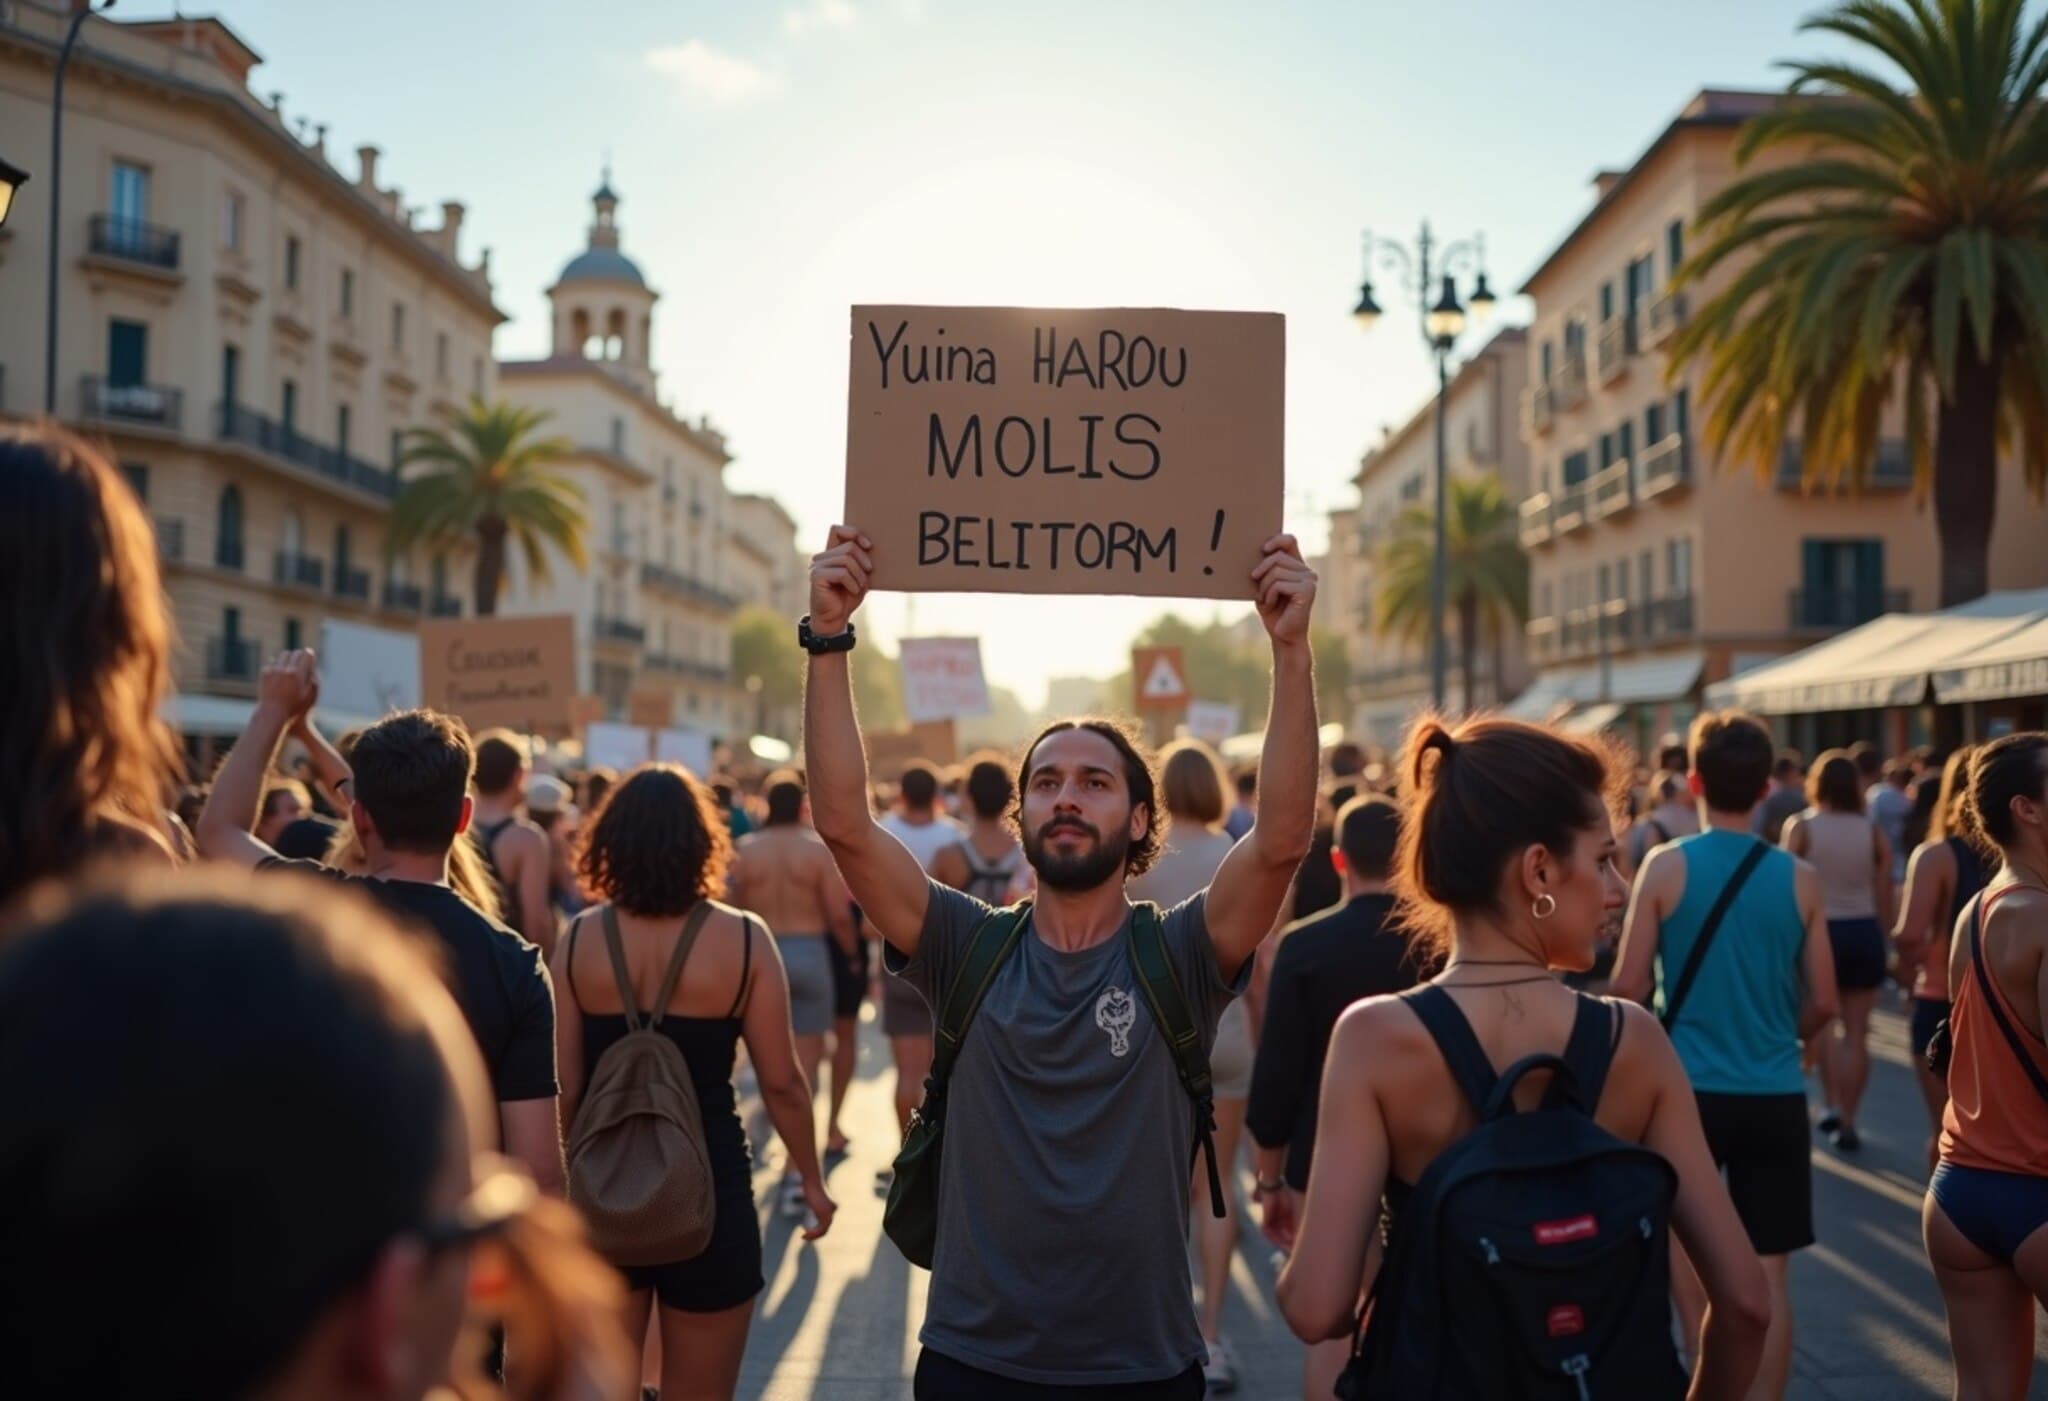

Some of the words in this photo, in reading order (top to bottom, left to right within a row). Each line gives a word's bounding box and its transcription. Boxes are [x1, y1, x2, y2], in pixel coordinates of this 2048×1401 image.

[868, 320, 996, 390] Yuina
[1033, 326, 1187, 392] HAROU
[927, 412, 1162, 481] MOLIS
[917, 510, 1177, 574] BELITORM
